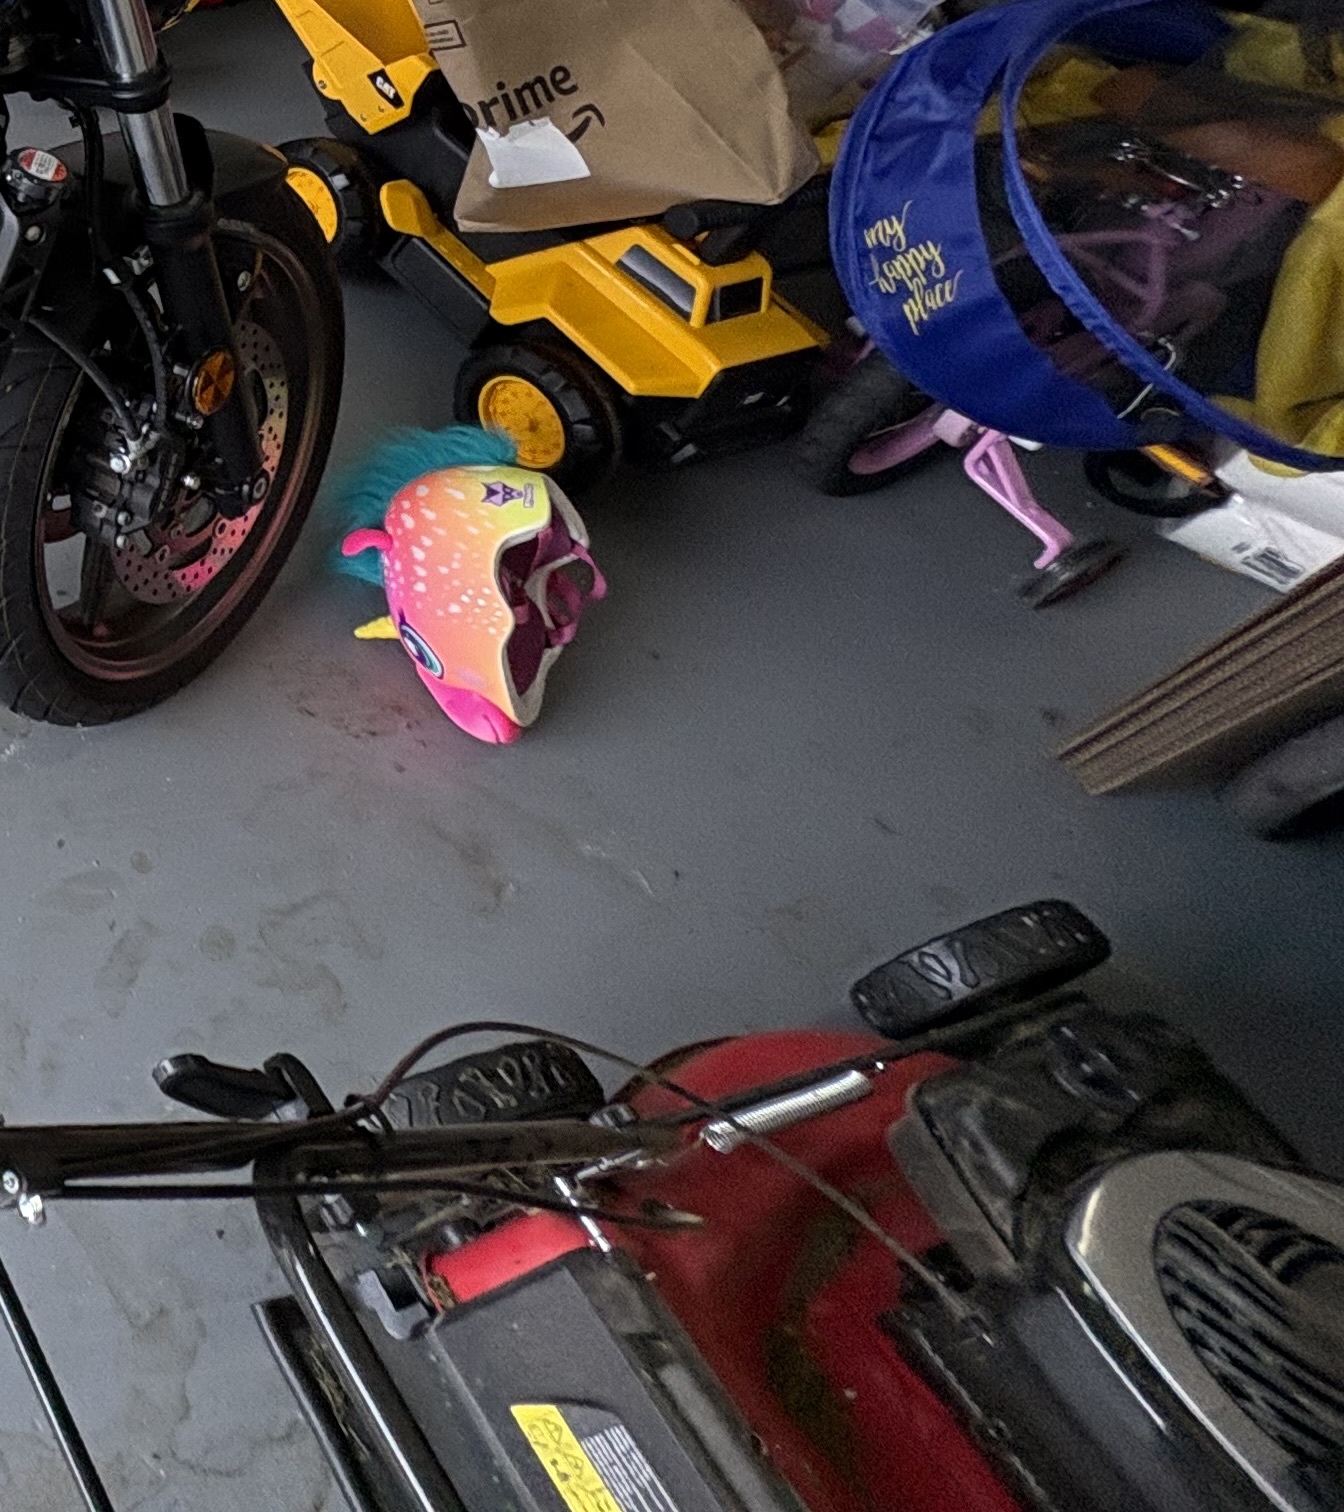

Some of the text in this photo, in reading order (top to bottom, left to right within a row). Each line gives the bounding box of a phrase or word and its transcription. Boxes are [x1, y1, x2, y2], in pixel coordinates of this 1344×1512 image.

[863, 199, 912, 252] my
[868, 240, 946, 294] happy
[902, 269, 964, 336] place
